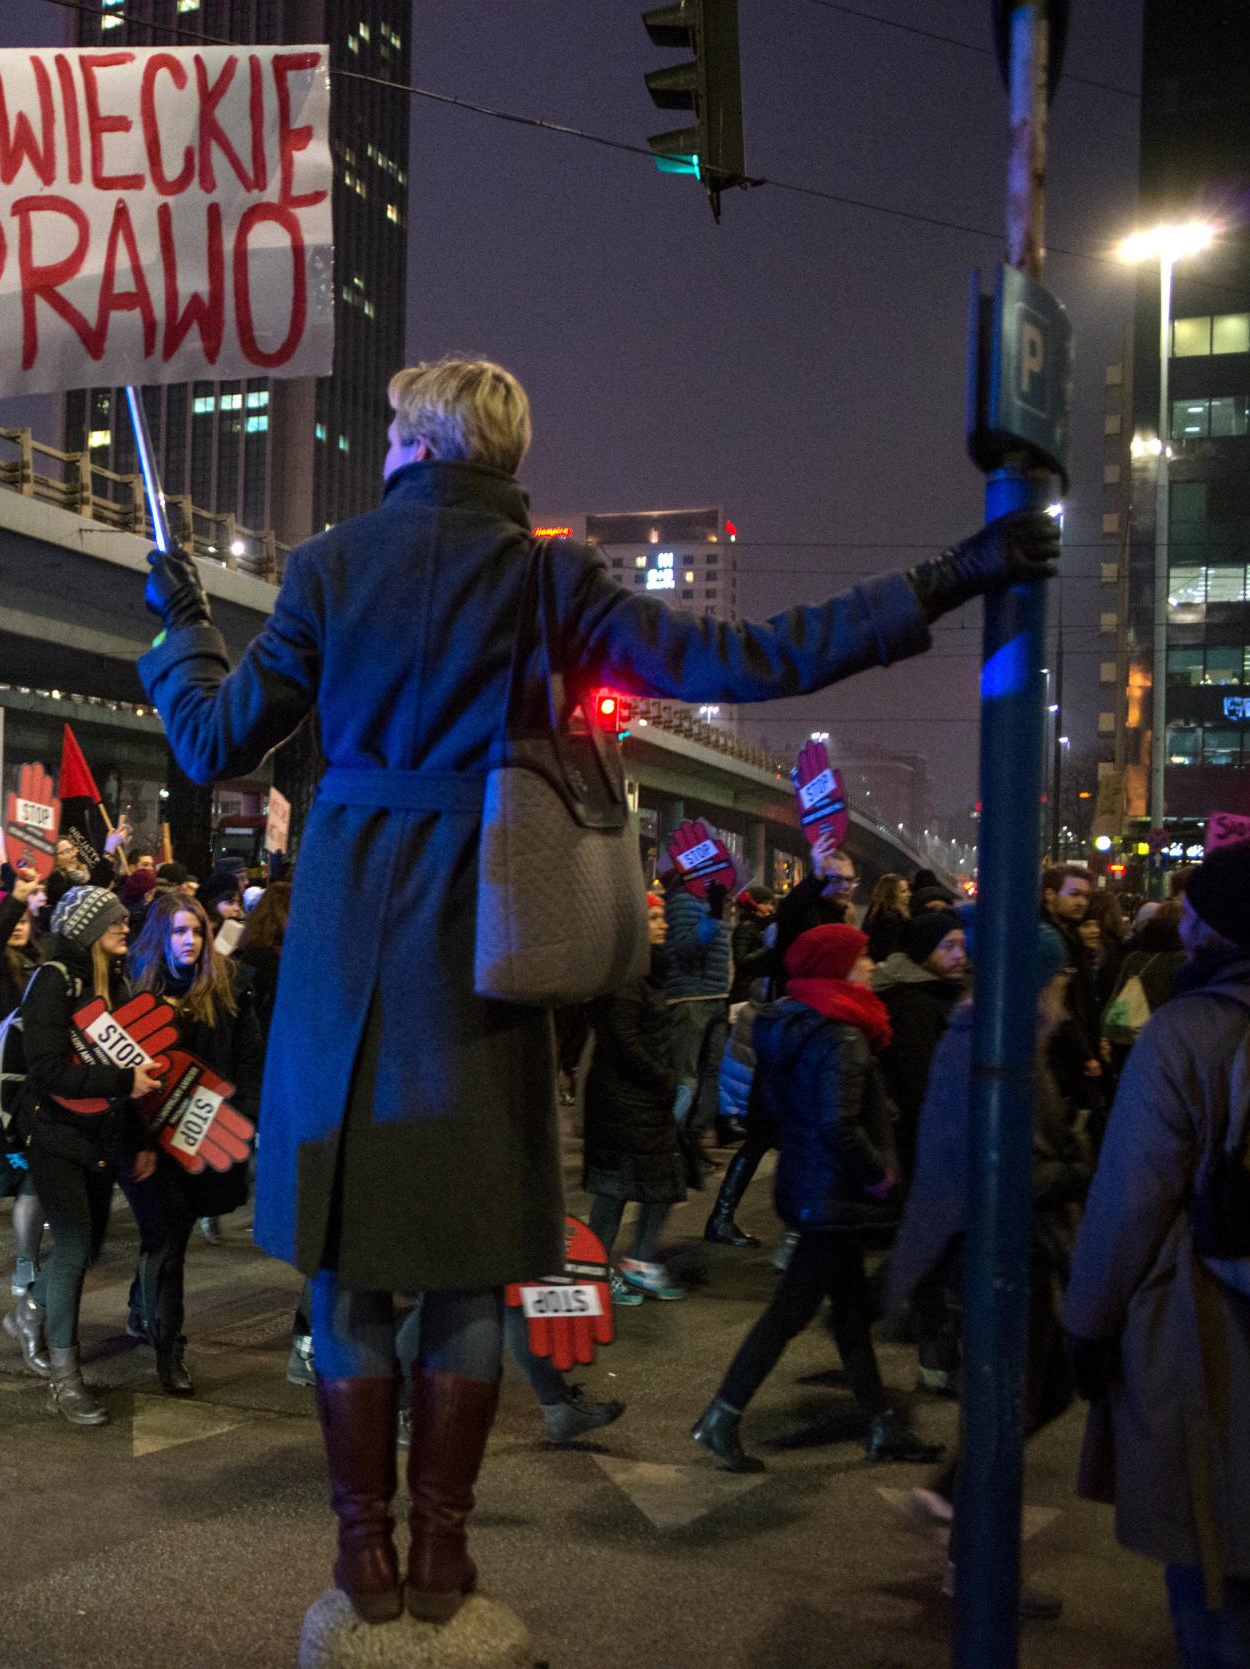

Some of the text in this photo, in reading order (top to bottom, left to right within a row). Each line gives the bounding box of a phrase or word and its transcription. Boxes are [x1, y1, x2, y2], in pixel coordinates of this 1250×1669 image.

[1021, 319, 1045, 393] P
[805, 774, 830, 802] STOP
[22, 803, 49, 825] STOP
[684, 843, 710, 866] STOP
[98, 1024, 145, 1069] STOP
[180, 1097, 214, 1148] STOP
[533, 1289, 590, 1314] STOP
